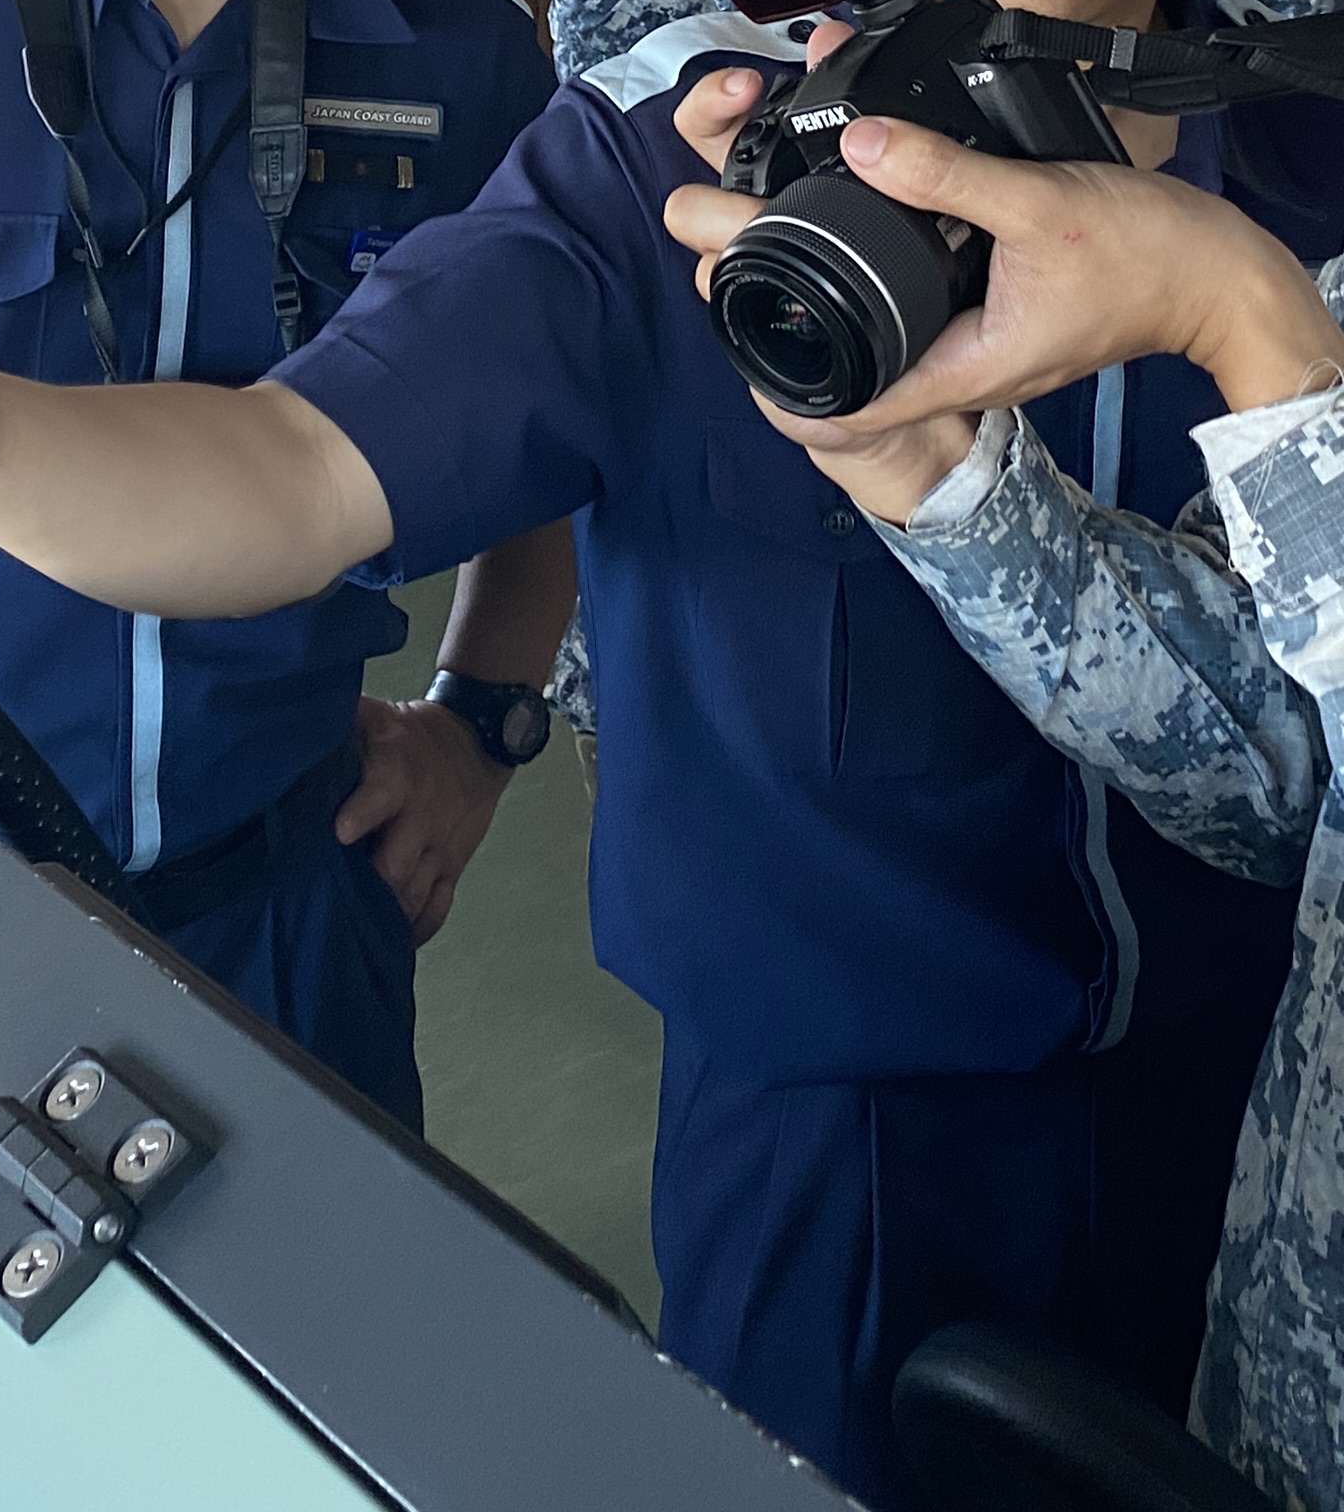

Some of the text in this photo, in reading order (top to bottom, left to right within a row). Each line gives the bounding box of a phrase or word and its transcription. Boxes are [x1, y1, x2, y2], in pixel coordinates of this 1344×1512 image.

[313, 106, 432, 127] JAPAN COAST GUARD
[790, 105, 851, 135] PENTAX
